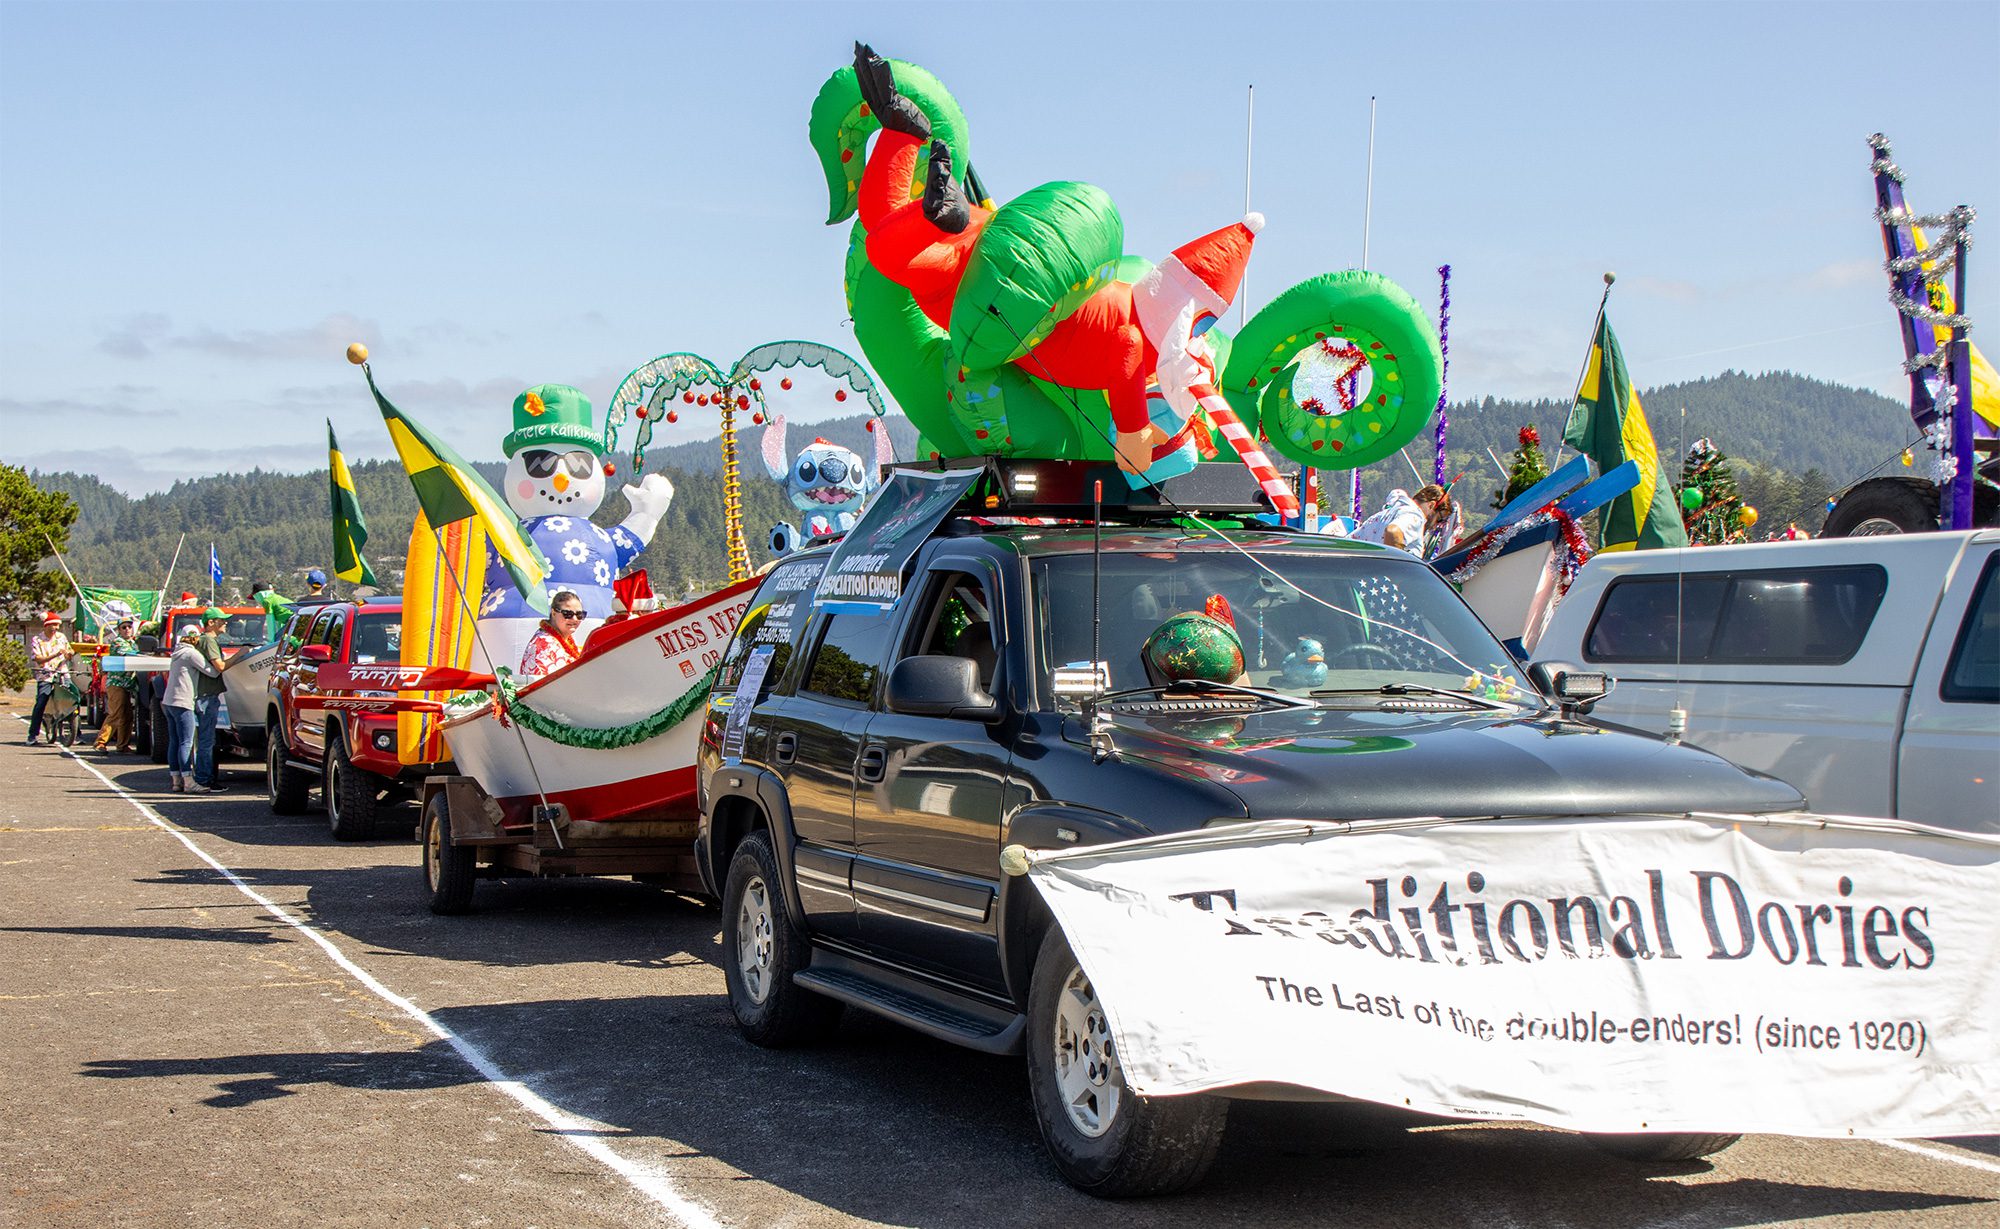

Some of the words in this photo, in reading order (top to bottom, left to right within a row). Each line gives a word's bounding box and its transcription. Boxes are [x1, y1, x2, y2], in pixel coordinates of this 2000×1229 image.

[655, 621, 709, 659] MISS
[1689, 870, 1935, 970] Dories
[1255, 975, 1324, 1008] The
[1332, 983, 1405, 1021] Last
[1414, 1001, 1442, 1028] of
[1449, 1006, 1495, 1042] the
[1505, 1010, 1740, 1045] double-enders!
[1755, 1015, 1841, 1054] (since
[1849, 1020, 1926, 1059] 1920)
